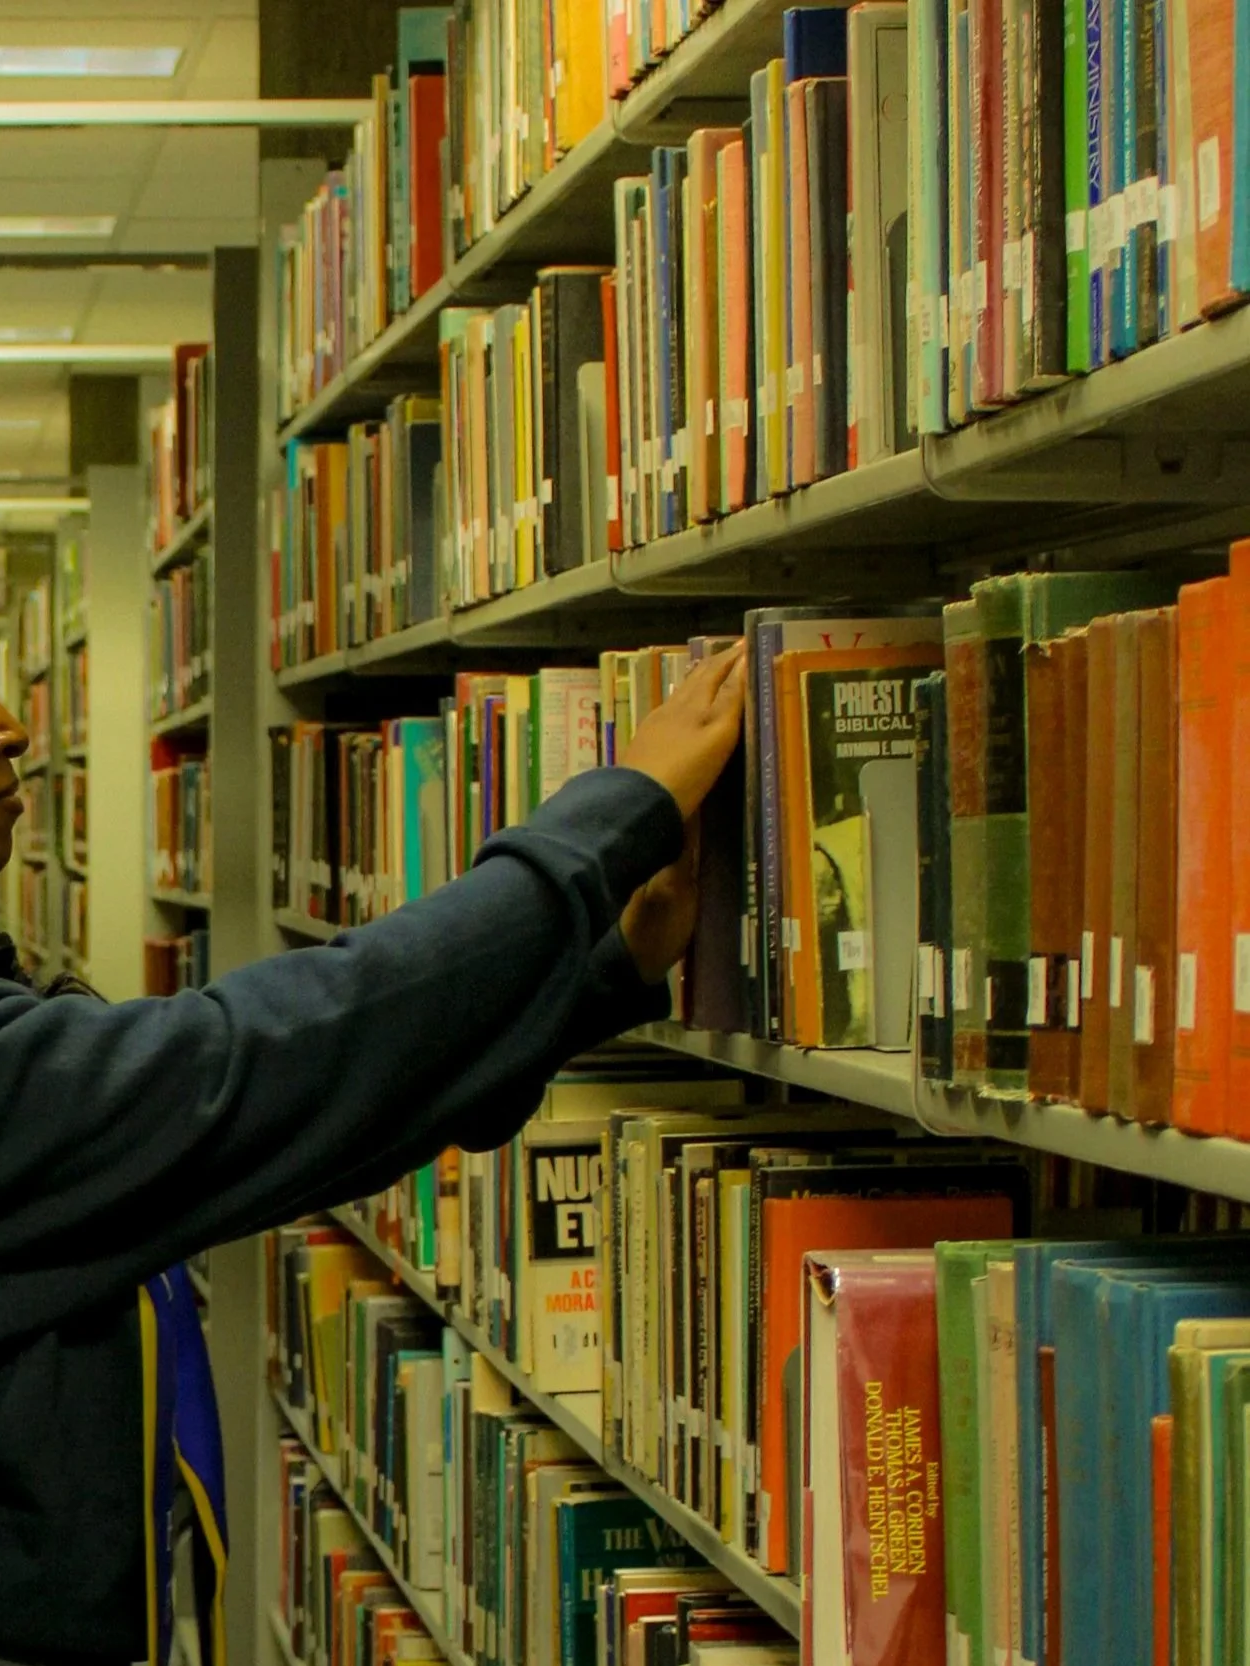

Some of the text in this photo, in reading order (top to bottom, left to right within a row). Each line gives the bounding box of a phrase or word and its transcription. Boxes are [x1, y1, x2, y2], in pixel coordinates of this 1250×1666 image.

[1087, 40, 1100, 188] MINISTRY
[834, 680, 904, 717] PRIEST
[836, 715, 913, 733] BIBLICAL
[767, 861, 777, 893] THE
[768, 904, 778, 959] ALTAR
[545, 1291, 596, 1313] MORA
[885, 1408, 904, 1487] THOMAS
[865, 1381, 890, 1602] DONALD E. HEINTSCHEL
[903, 1405, 927, 1575] JAMES A. CORIDEN
[925, 1461, 940, 1519] Edited by
[602, 1527, 646, 1551] THE
[888, 1510, 907, 1574] GREEN
